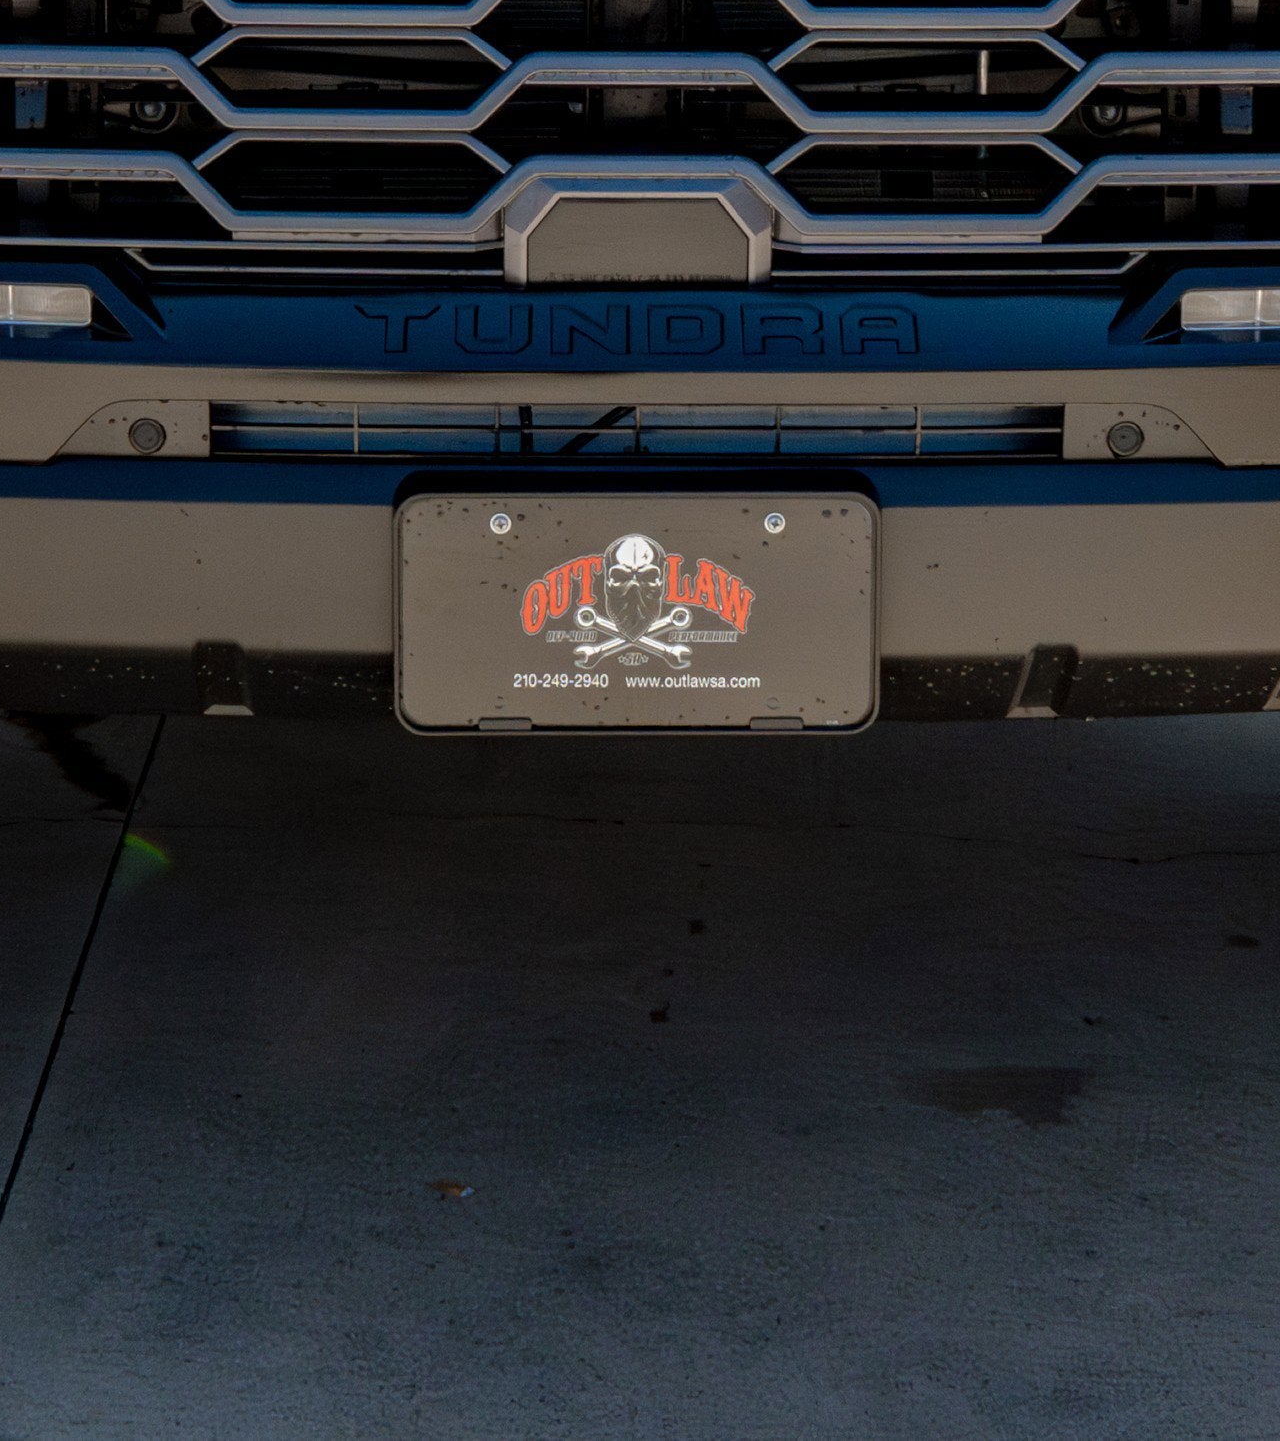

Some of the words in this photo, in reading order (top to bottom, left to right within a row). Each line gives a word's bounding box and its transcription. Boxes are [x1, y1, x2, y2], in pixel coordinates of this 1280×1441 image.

[354, 304, 920, 354] TUNDRA
[521, 554, 605, 636] OUT
[665, 553, 757, 635] LAW
[513, 673, 609, 689] 210-249-2940
[625, 673, 761, 689] www.outlawsa.com
